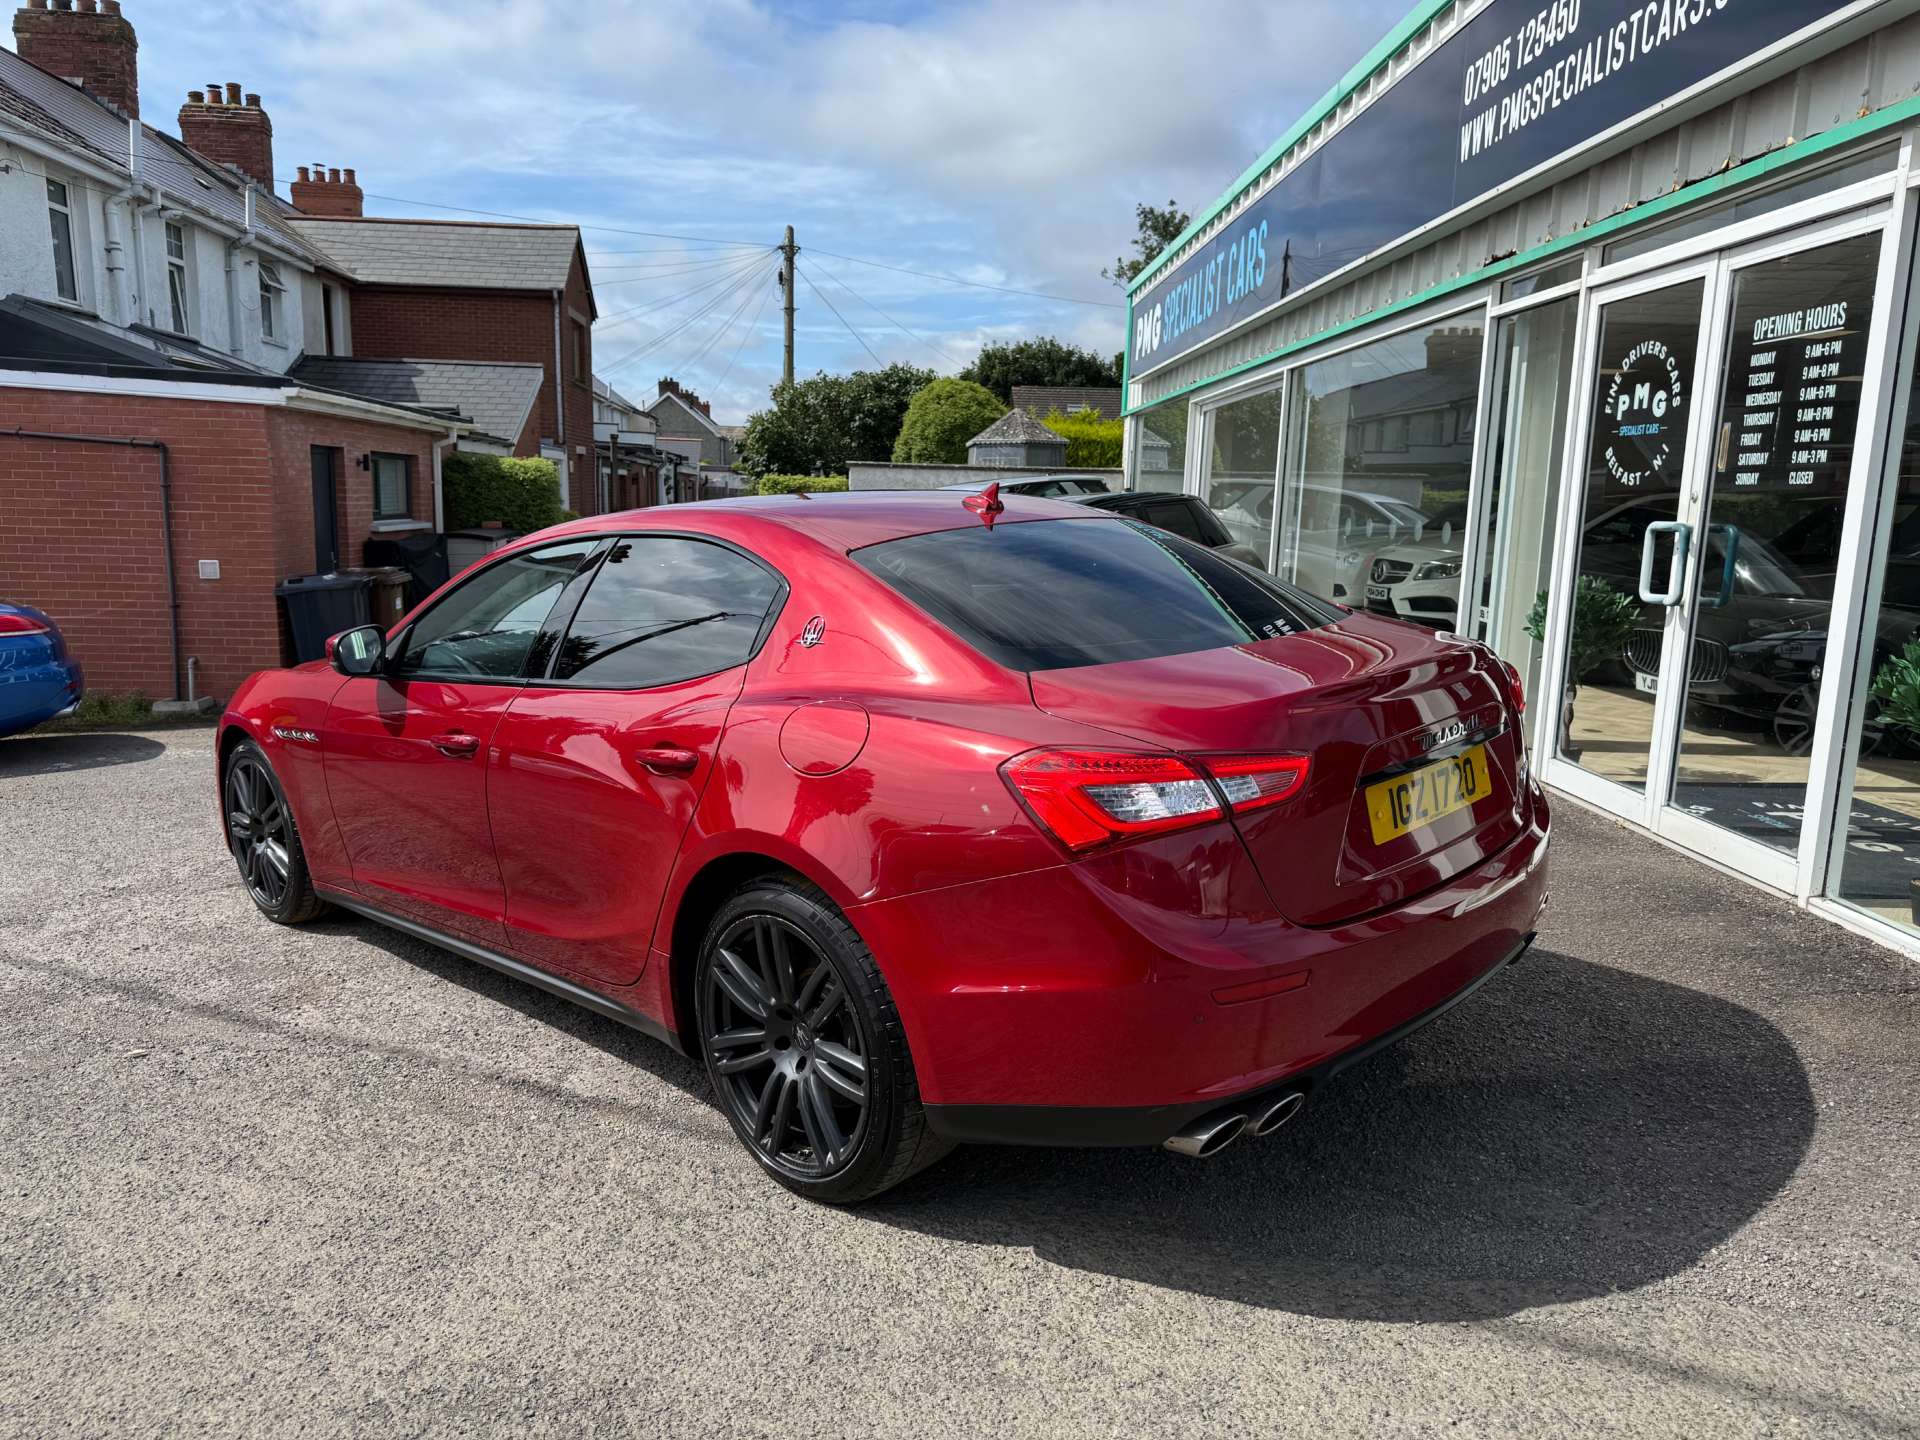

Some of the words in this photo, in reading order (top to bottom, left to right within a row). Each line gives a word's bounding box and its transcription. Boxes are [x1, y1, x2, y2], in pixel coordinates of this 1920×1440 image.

[1464, 36, 1512, 106] 07905
[1516, 0, 1581, 70] 125450
[1135, 303, 1162, 361] PMG
[1163, 252, 1225, 344] SPECIALIST
[1226, 219, 1268, 305] CARS
[1753, 310, 1803, 341] OPENING
[1804, 301, 1847, 332] HOURS
[1750, 351, 1776, 367] MONDAY
[1805, 345, 1811, 359] 9
[1830, 340, 1842, 355] PM
[1605, 372, 1622, 414] FINE
[1622, 340, 1667, 372] DRIVERS
[1666, 356, 1681, 408] CARS
[1748, 372, 1775, 387] TUESDAY
[1802, 366, 1808, 380] 9
[1827, 362, 1839, 377] PM
[1616, 382, 1667, 421] PMG
[1745, 391, 1782, 407] WEDNESDAY
[1800, 387, 1805, 401] 9
[1824, 384, 1837, 398] PM
[1743, 411, 1774, 427] THURSDAY
[1797, 408, 1802, 422] 9
[1821, 406, 1834, 420] PM
[1740, 432, 1762, 447] FRIDAY
[1794, 430, 1799, 443] 9
[1819, 428, 1831, 441] PM
[1605, 446, 1642, 486] BELFAST
[1737, 452, 1769, 466] SATURDAY
[1791, 451, 1797, 464] 9
[1816, 450, 1828, 464] PM
[1735, 472, 1760, 486] SUNDAY
[1789, 471, 1814, 485] CLOSED
